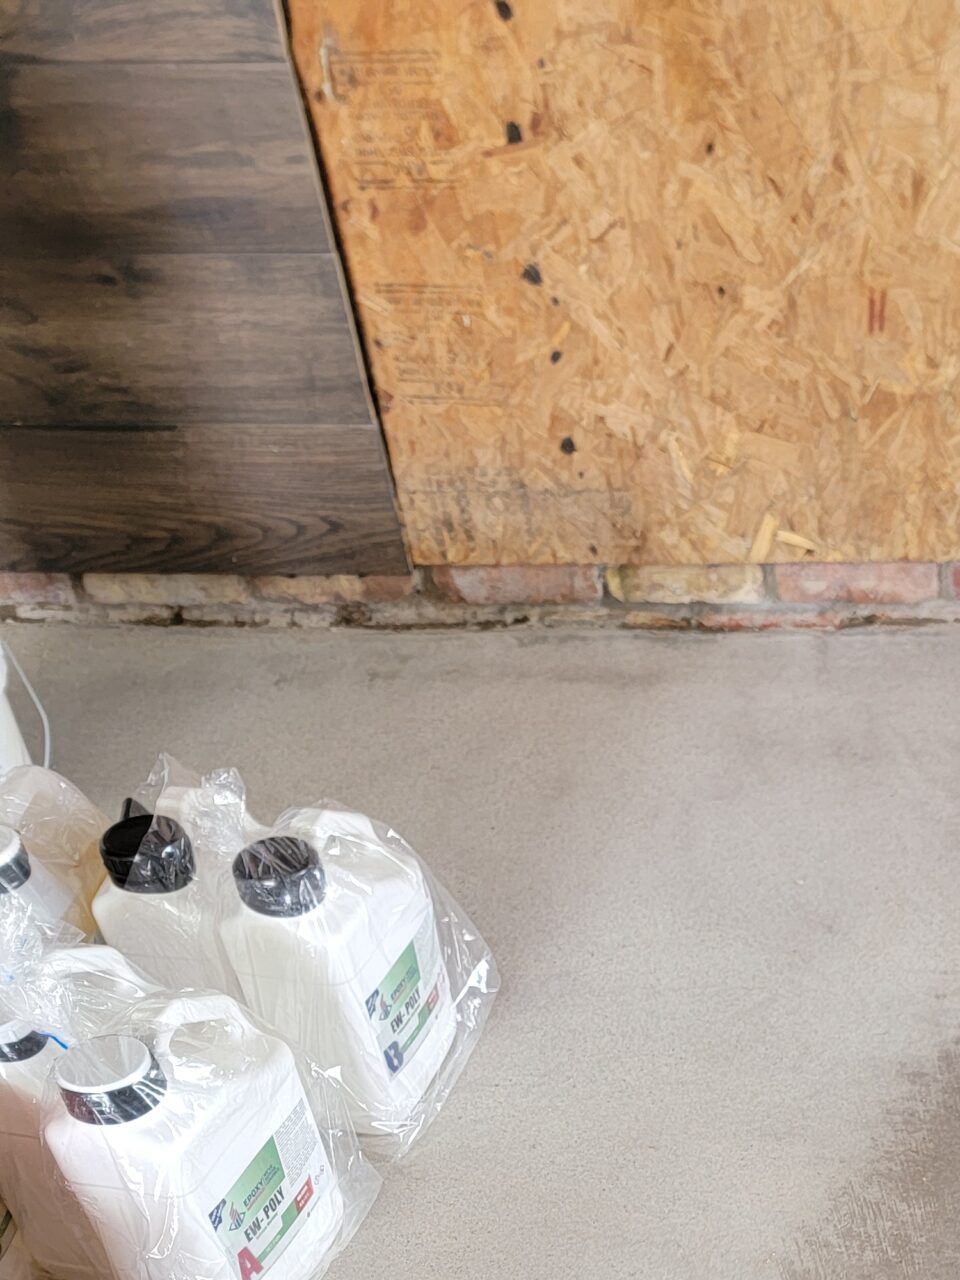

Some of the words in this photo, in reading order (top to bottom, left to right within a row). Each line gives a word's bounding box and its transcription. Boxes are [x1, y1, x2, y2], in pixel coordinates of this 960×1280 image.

[405, 988, 421, 1015] POLY
[243, 1178, 263, 1207] EPOXY
[263, 1185, 285, 1220] POLY
